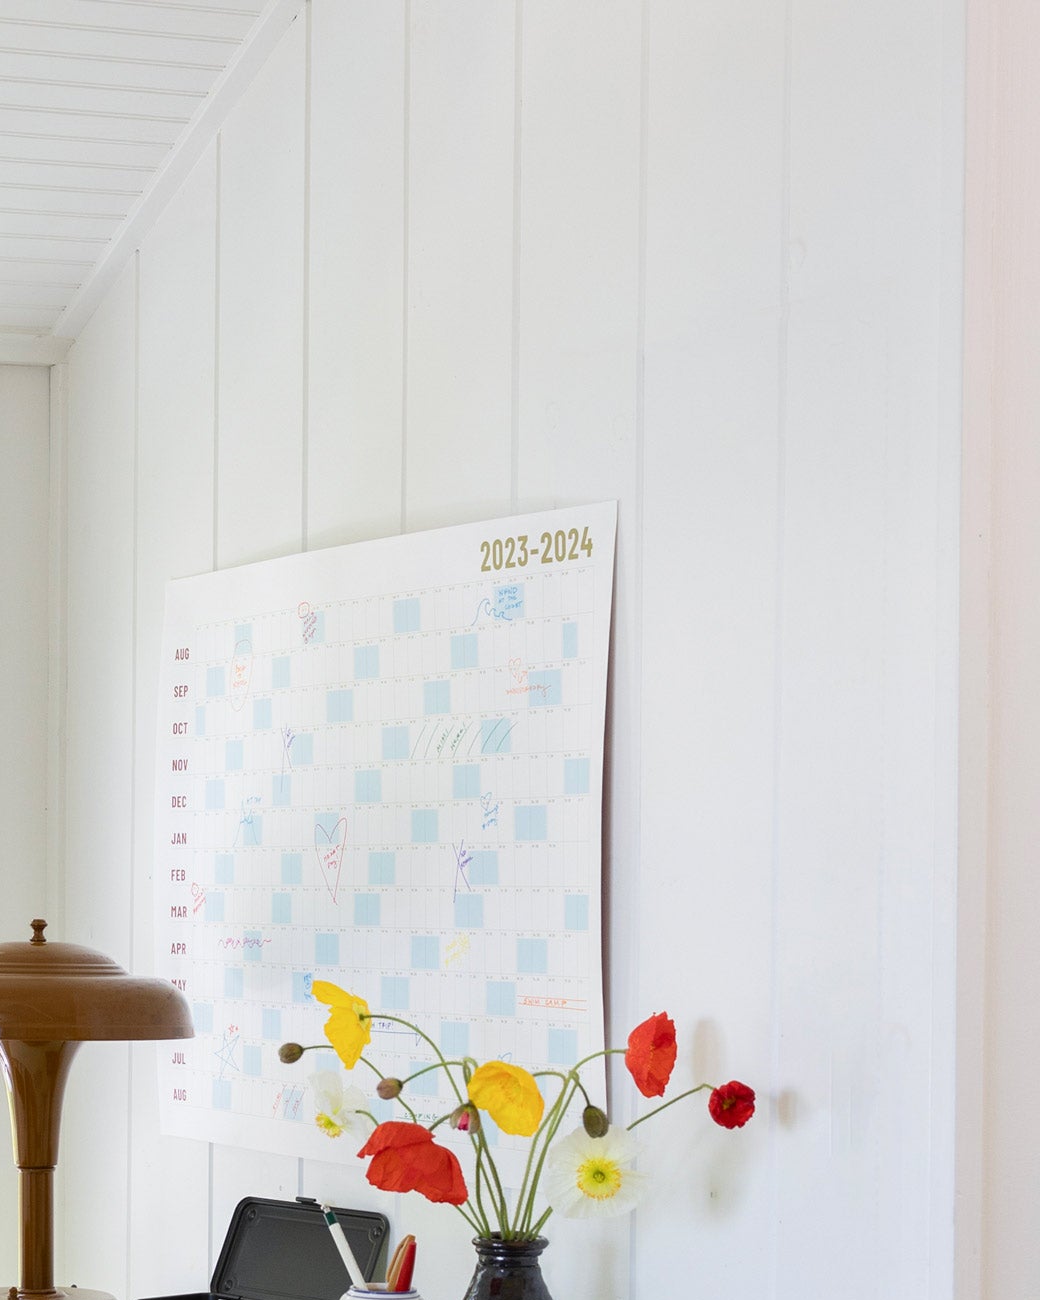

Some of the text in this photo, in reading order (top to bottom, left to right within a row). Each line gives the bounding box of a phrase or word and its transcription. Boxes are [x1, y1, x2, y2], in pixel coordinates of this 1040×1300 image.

[480, 526, 593, 572] 2023-2024
[175, 648, 190, 661] AUG
[174, 685, 189, 698] SEP
[173, 722, 188, 735] OCT
[172, 759, 189, 772] NOV
[171, 796, 187, 808] DEC
[171, 832, 187, 845] JAN
[171, 869, 186, 881] FEB
[171, 906, 188, 918] MAR
[171, 943, 187, 955] APR
[172, 1052, 186, 1065] JUL
[173, 1088, 187, 1101] AUG
